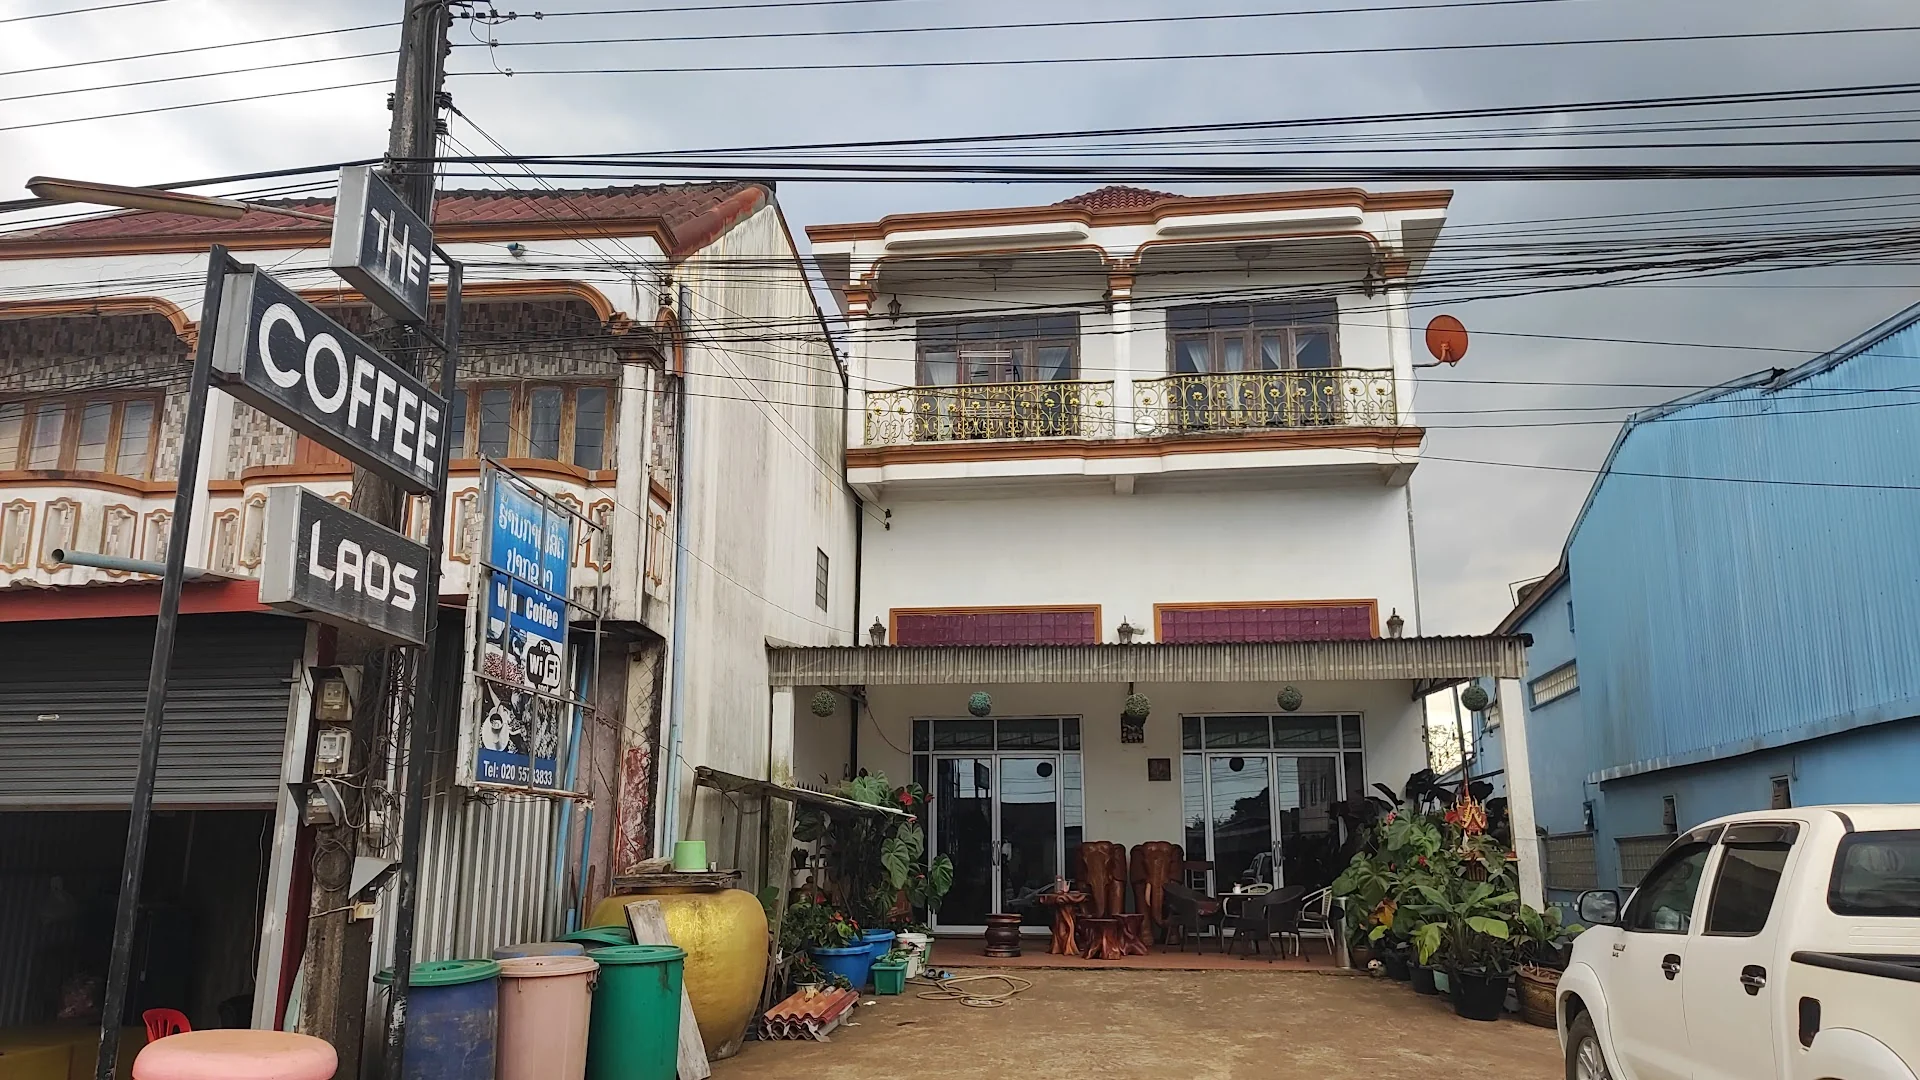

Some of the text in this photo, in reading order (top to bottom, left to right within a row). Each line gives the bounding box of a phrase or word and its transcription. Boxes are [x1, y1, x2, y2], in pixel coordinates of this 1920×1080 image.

[371, 207, 427, 285] THE
[258, 302, 440, 475] COFFEE
[308, 519, 419, 612] LAOS
[525, 596, 559, 630] Coffee
[540, 640, 551, 653] Free
[483, 760, 499, 778] Tel:
[501, 763, 516, 781] 020
